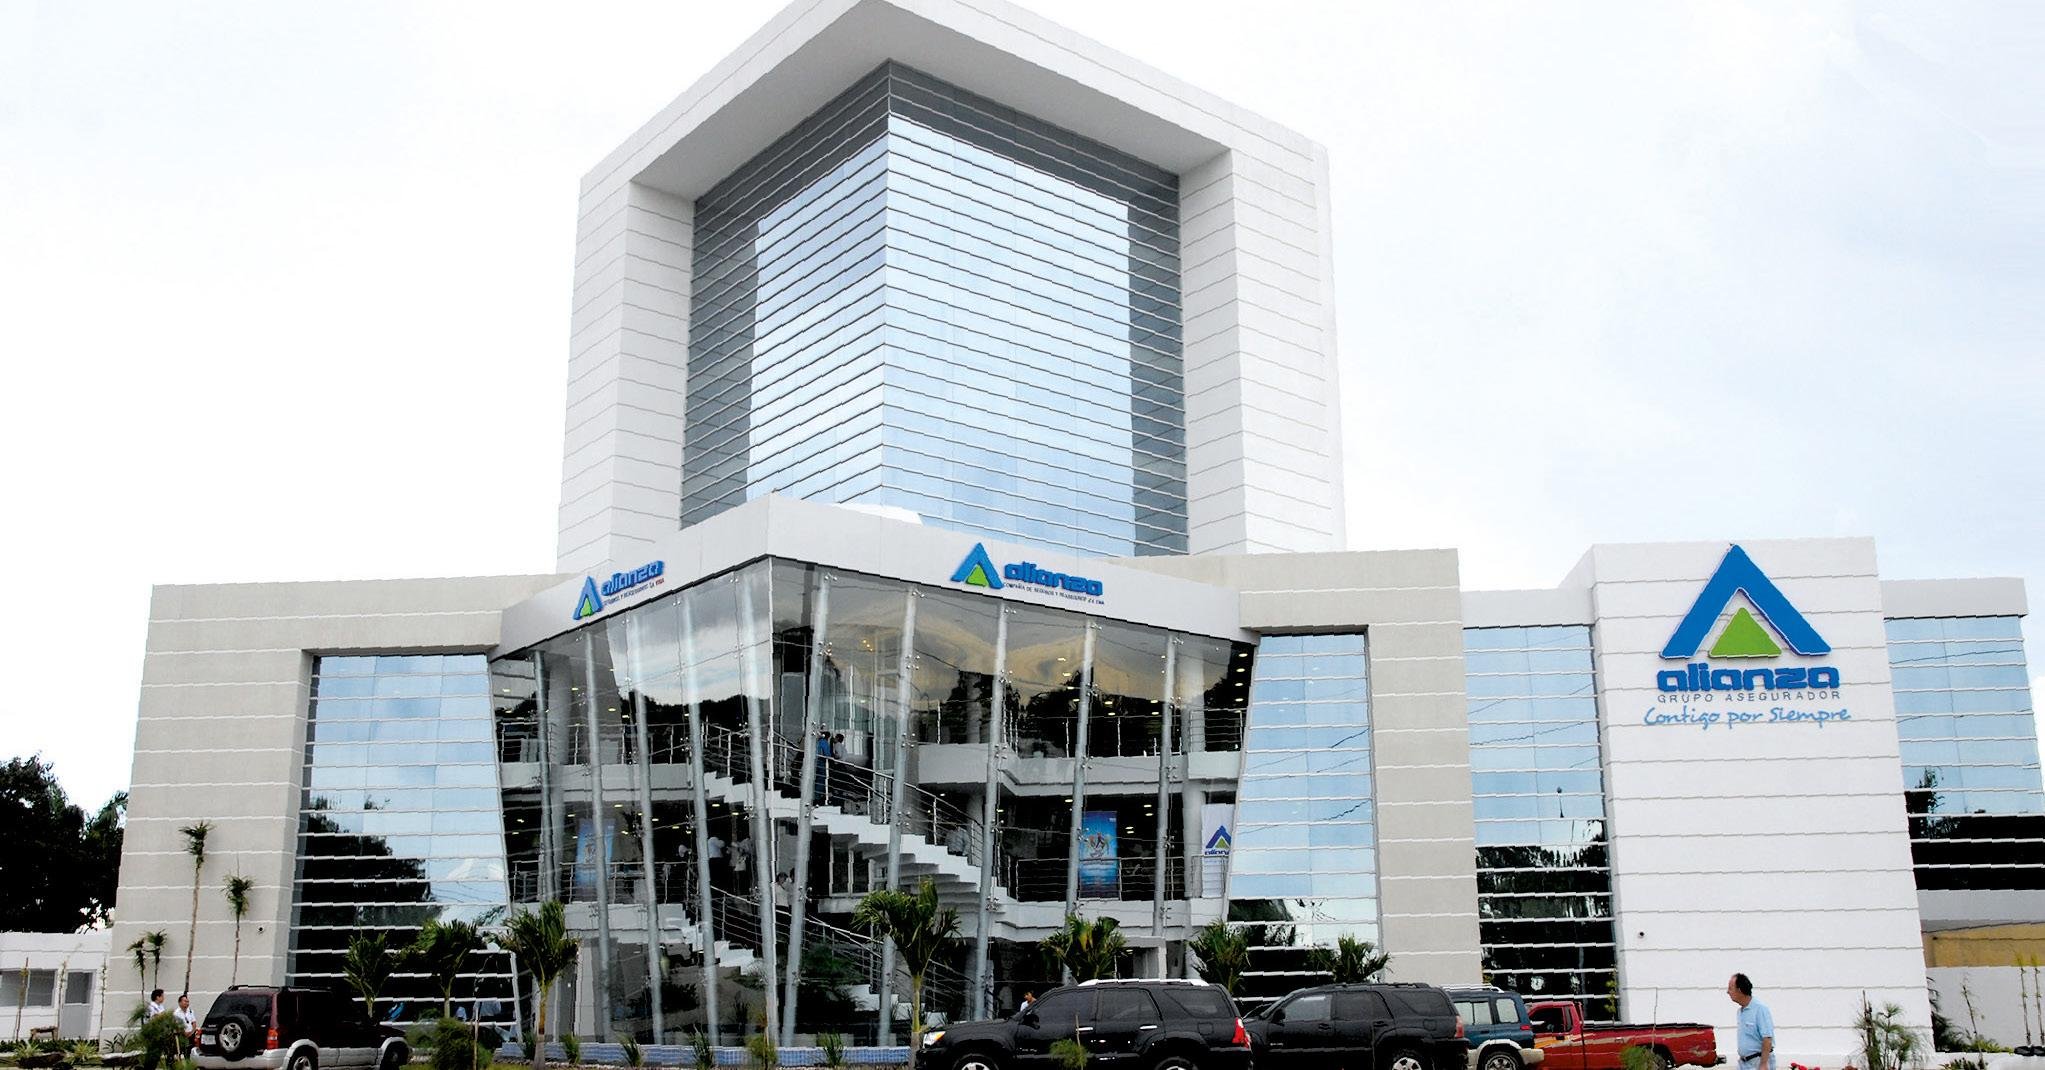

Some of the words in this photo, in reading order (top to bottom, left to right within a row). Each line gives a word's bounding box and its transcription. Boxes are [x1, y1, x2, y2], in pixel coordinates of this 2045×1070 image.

[601, 560, 665, 596] alianza
[1005, 561, 1103, 596] alianza
[1657, 663, 1840, 692] alianza
[1657, 693, 1713, 703] GRUPO
[1725, 691, 1840, 701] ASEGURADOR
[1644, 705, 1720, 730] Contigo
[1727, 712, 1763, 729] por
[1769, 706, 1851, 728] Siempre
